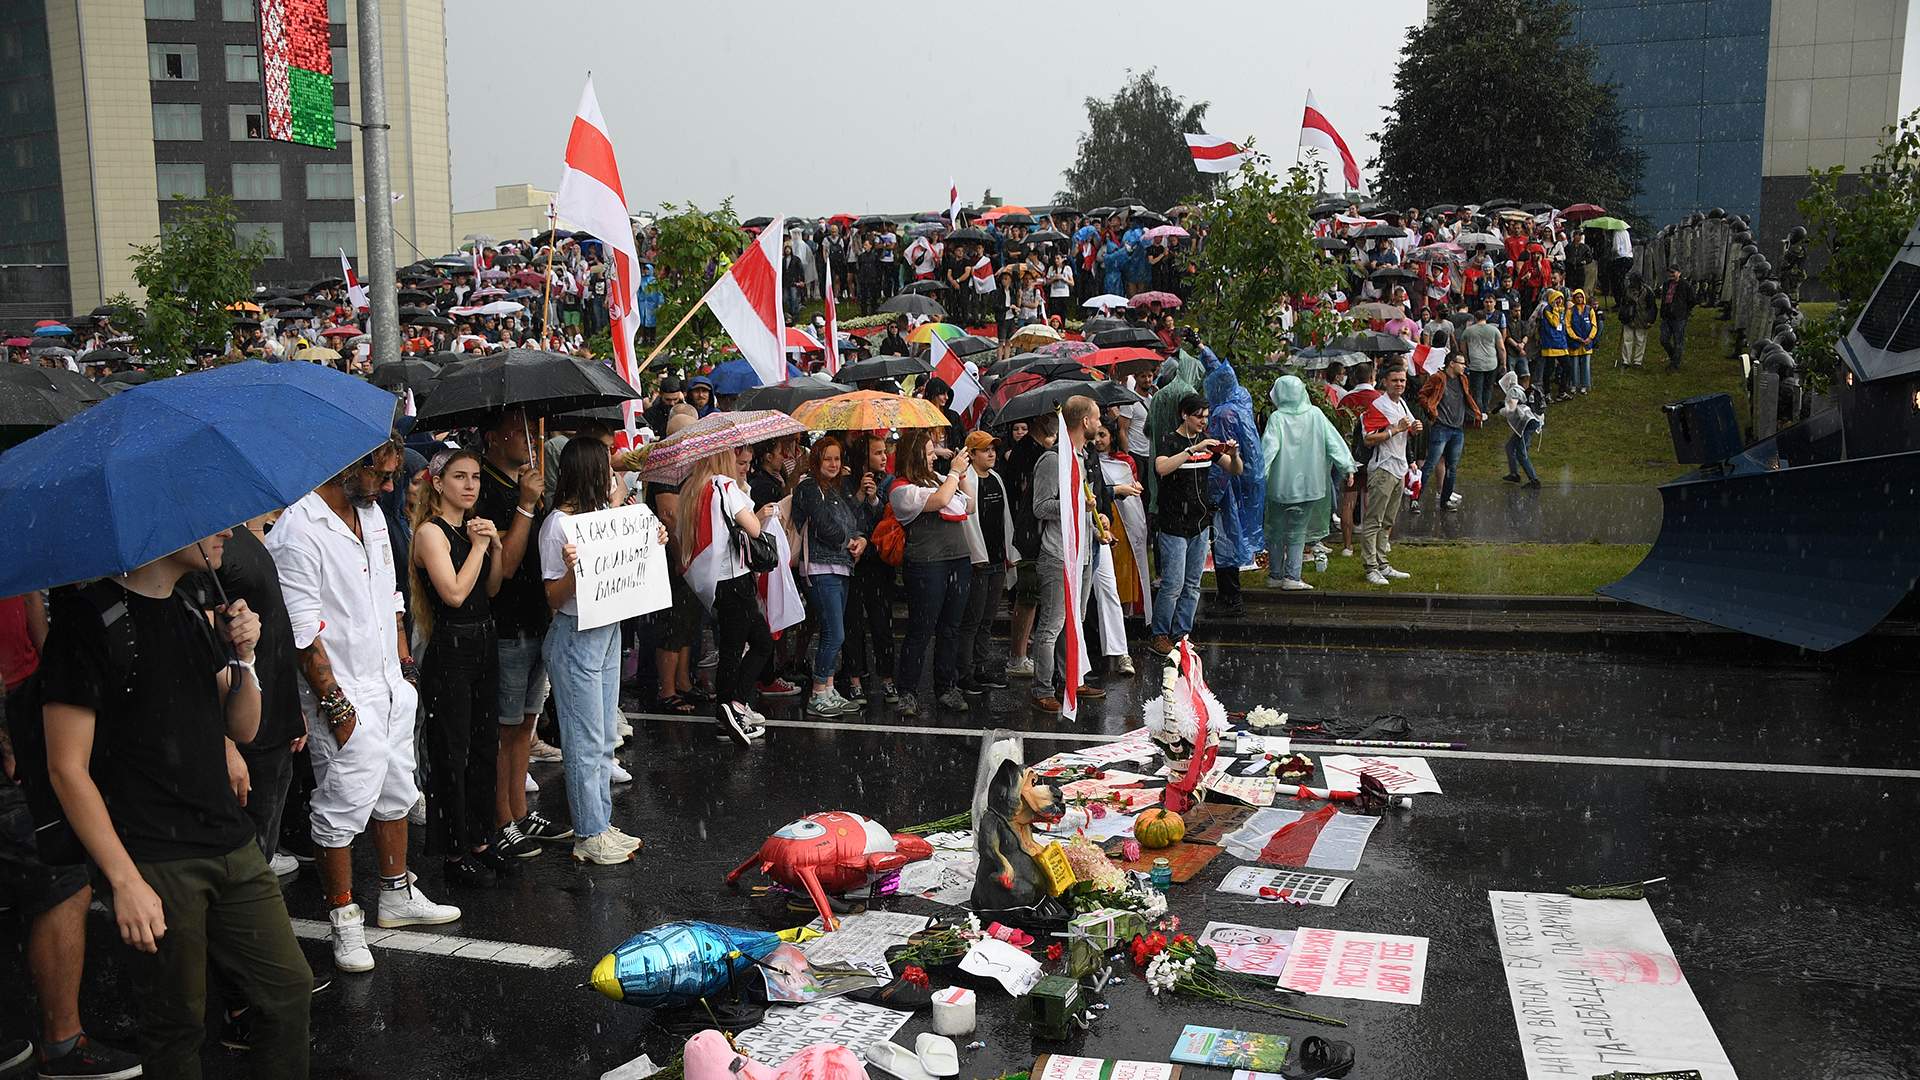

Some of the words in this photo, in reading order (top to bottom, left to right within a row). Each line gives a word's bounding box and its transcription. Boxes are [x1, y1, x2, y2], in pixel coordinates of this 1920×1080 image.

[576, 522, 586, 544] А
[576, 558, 585, 578] А
[1332, 940, 1376, 988] РАССТАТЬСЯ
[1378, 941, 1414, 962] ТЕБЕ
[1516, 977, 1558, 1028] BIRTHDAY
[1528, 1033, 1579, 1076] HAPPY
